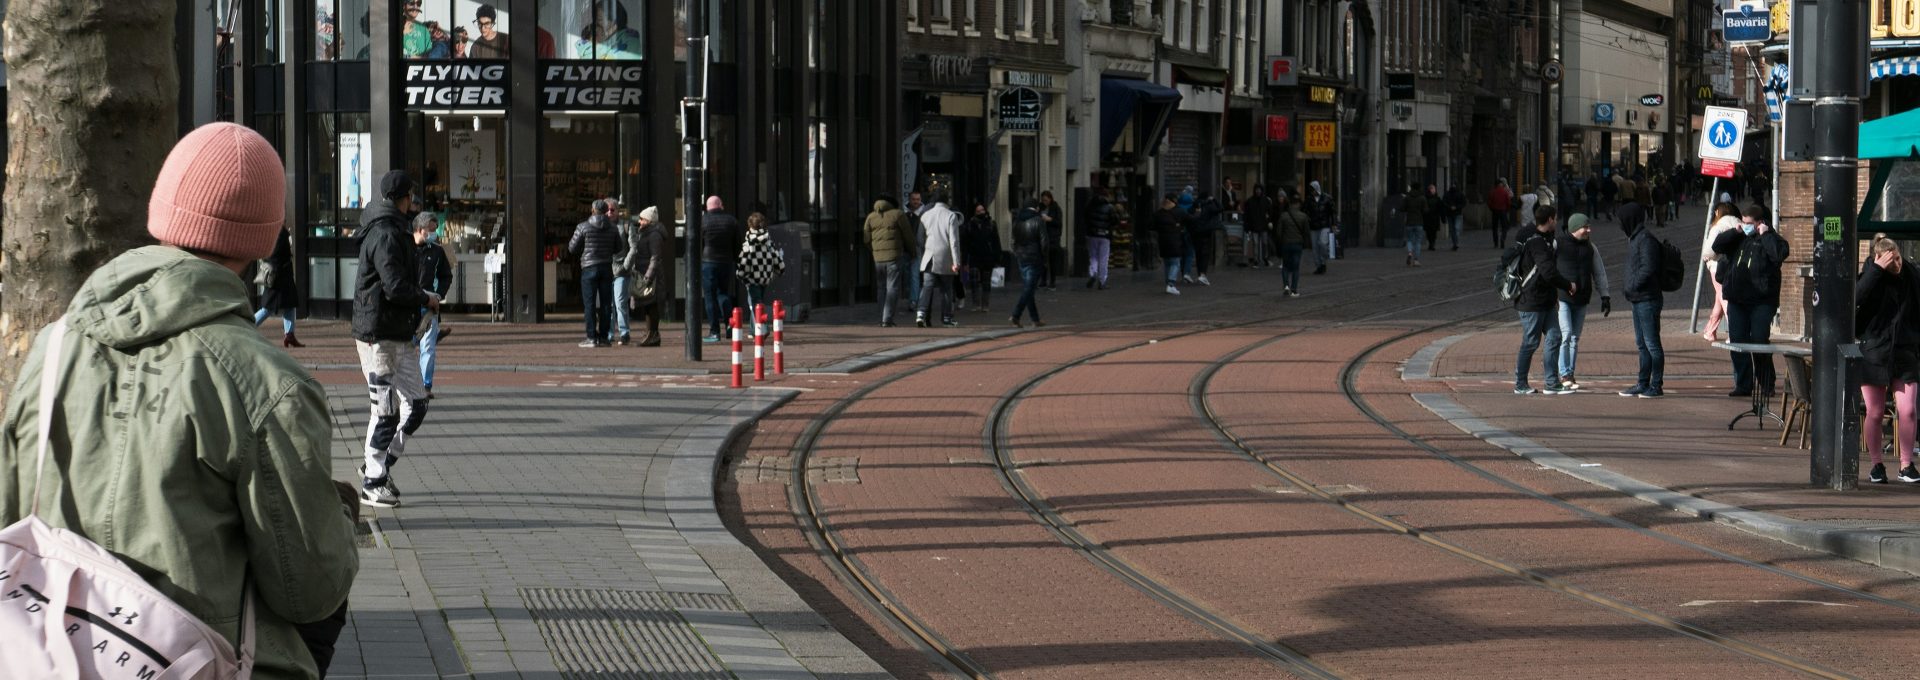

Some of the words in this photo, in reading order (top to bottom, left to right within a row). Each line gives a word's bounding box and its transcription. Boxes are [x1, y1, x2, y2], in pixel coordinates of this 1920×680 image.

[1726, 17, 1768, 28] Bavaria
[406, 65, 505, 81] FLYING
[546, 65, 643, 81] FLYING
[929, 54, 973, 86] TATTOO
[1272, 60, 1292, 81] F
[405, 86, 505, 105] TIGER
[543, 86, 643, 105] TIGER
[1826, 222, 1839, 231] GIF
[0, 570, 80, 637] UNDR
